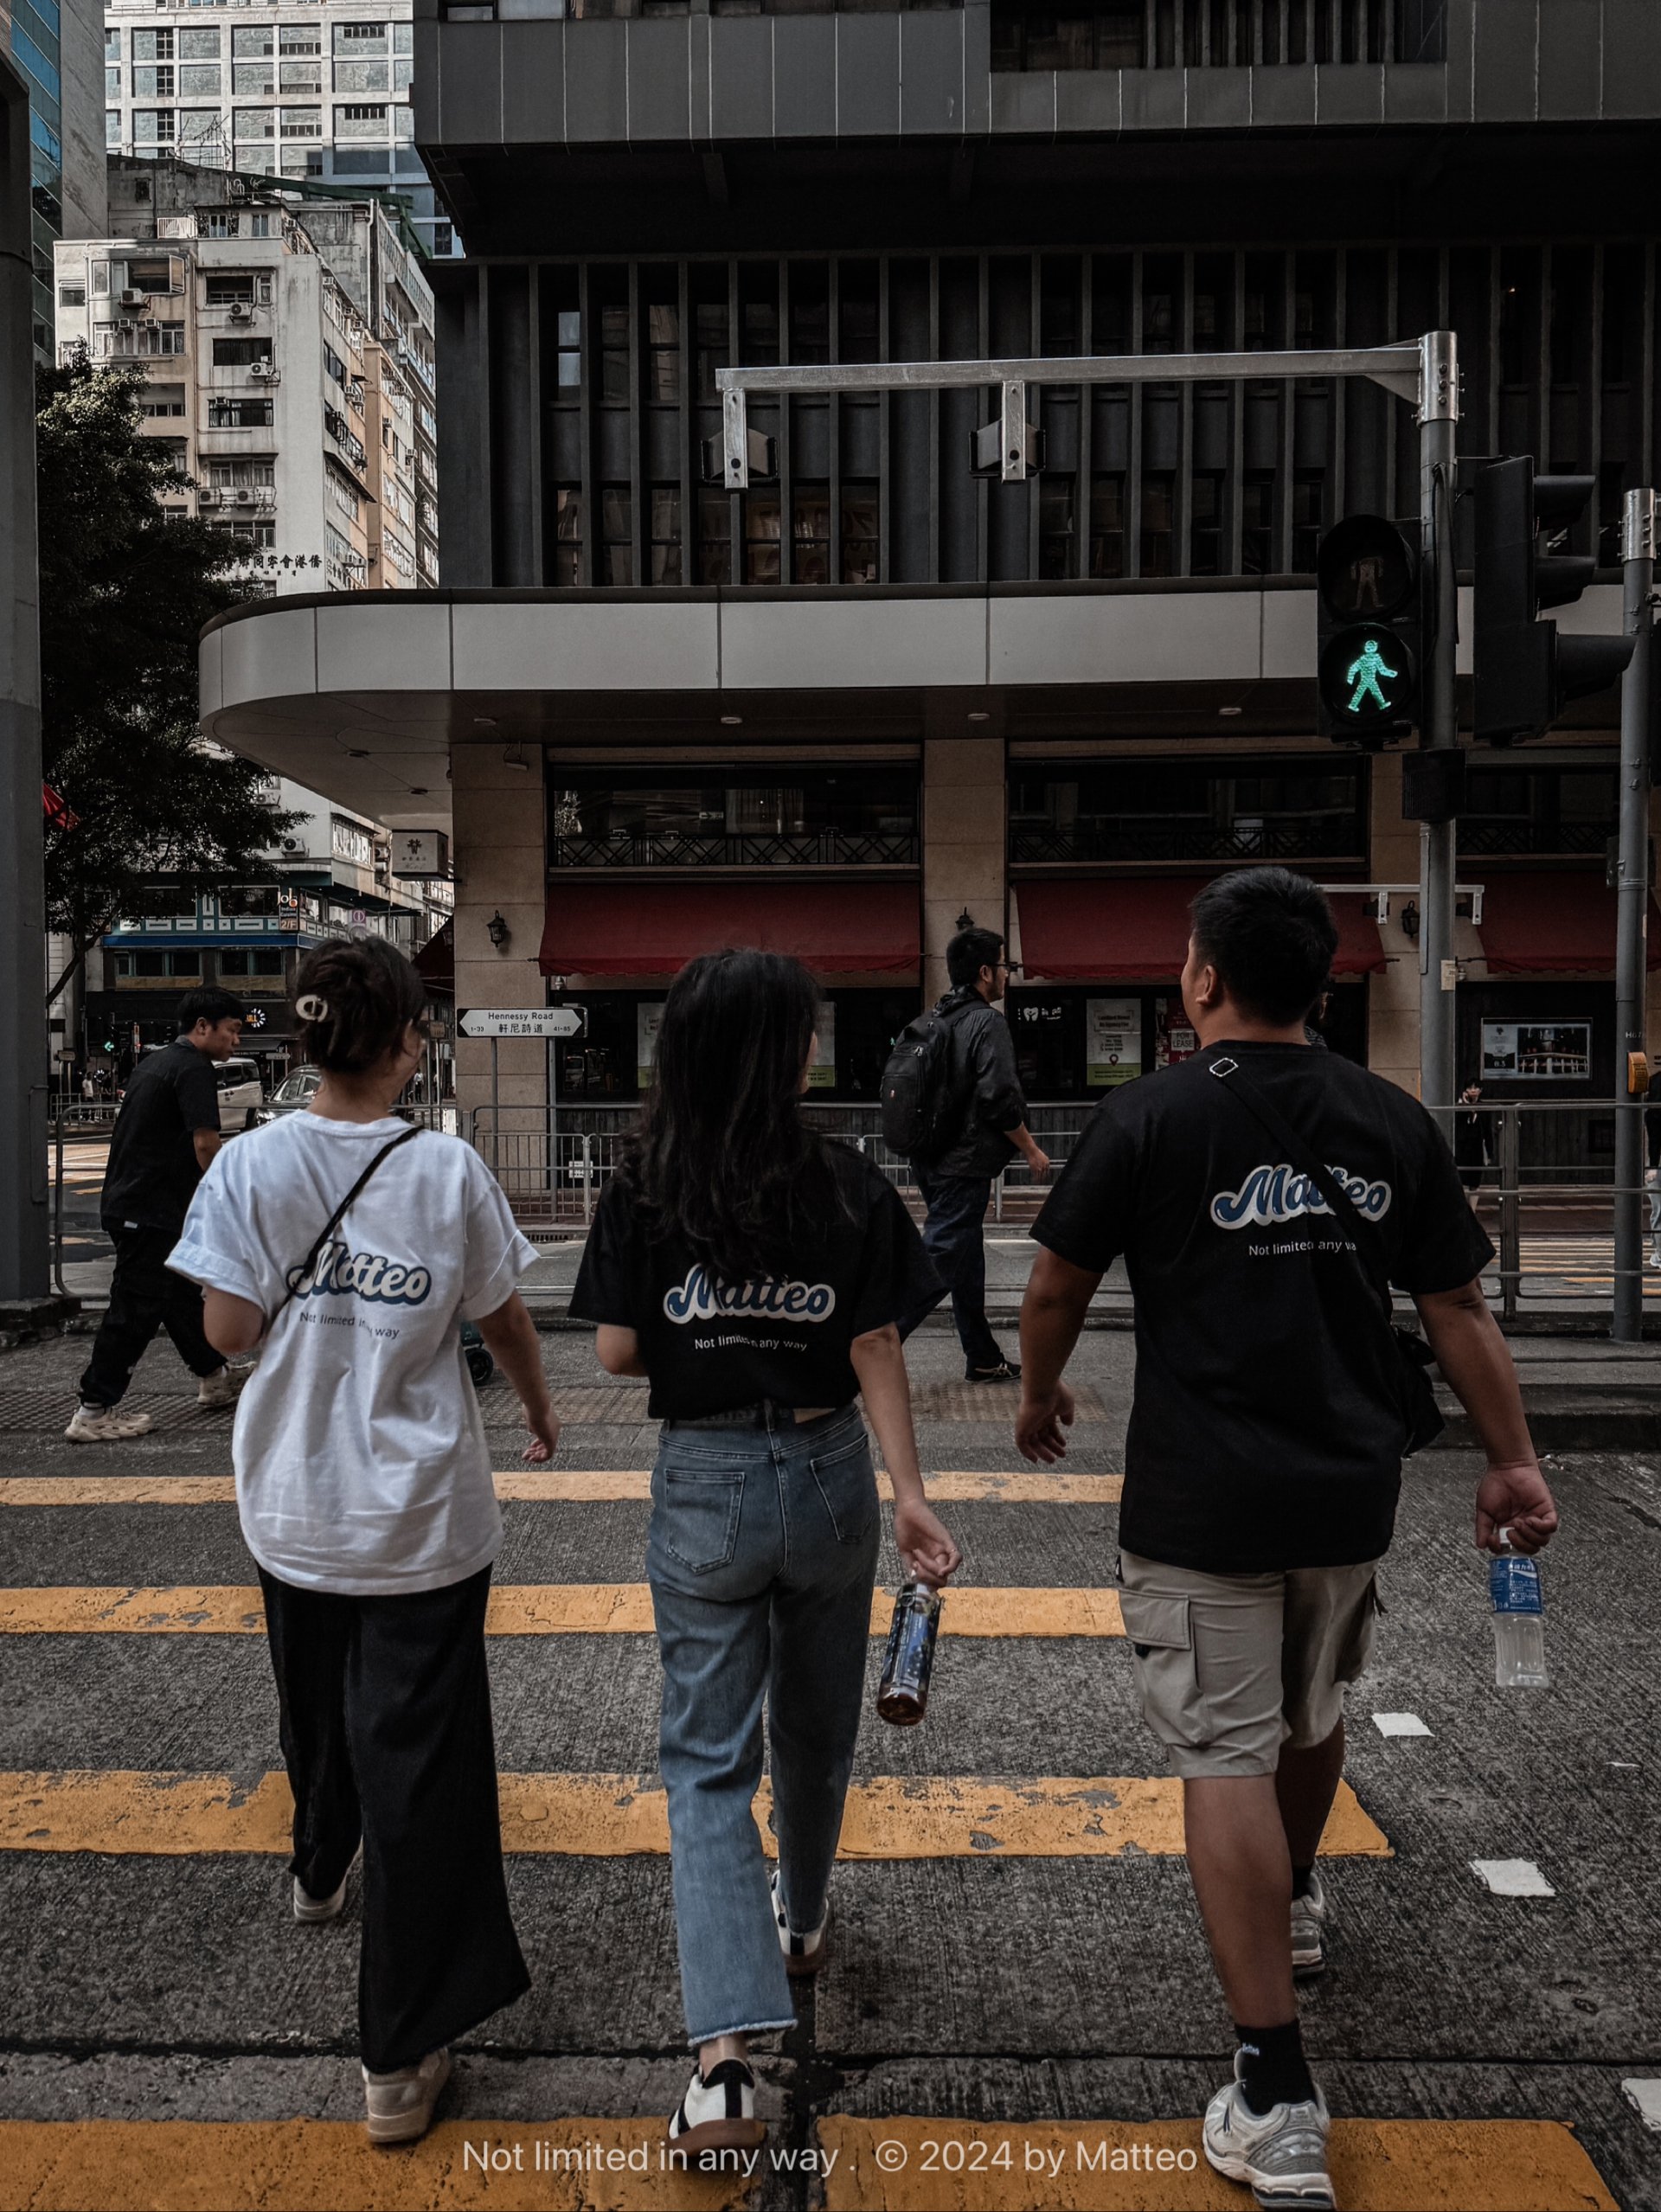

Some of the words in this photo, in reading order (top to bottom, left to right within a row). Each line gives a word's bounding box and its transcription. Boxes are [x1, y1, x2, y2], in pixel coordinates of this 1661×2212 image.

[280, 919, 297, 929] 2/F
[488, 1012, 529, 1021] Hennessy
[498, 1023, 543, 1034] 軒尼詩道
[1248, 1245, 1269, 1256] Not
[1318, 1241, 1343, 1253] any
[375, 1328, 401, 1340] way
[694, 1338, 715, 1350] Not
[760, 1338, 779, 1350] any
[782, 1341, 808, 1352] way
